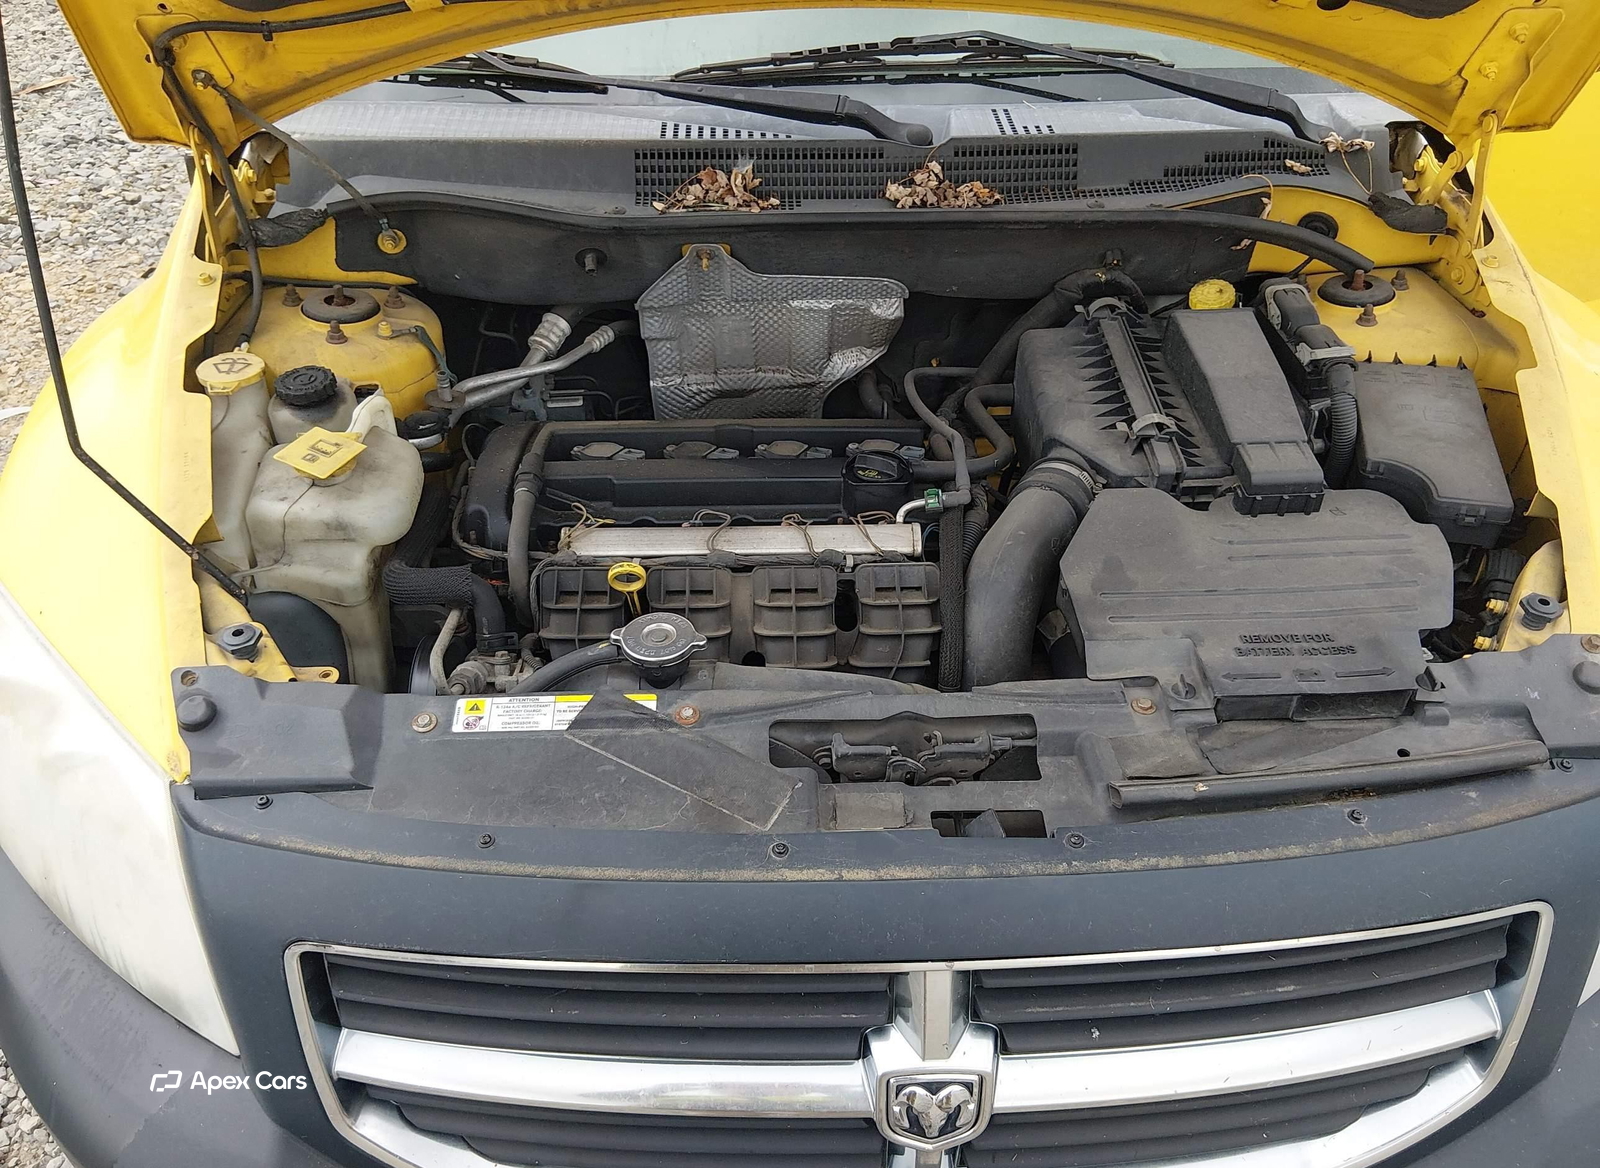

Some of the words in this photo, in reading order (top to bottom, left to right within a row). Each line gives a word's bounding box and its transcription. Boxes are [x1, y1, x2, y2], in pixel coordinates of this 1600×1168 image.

[1239, 633, 1302, 644] REMOVE
[1303, 633, 1335, 643] FOR
[1234, 646, 1295, 657] BATTERY
[1301, 645, 1357, 657] ACCESS
